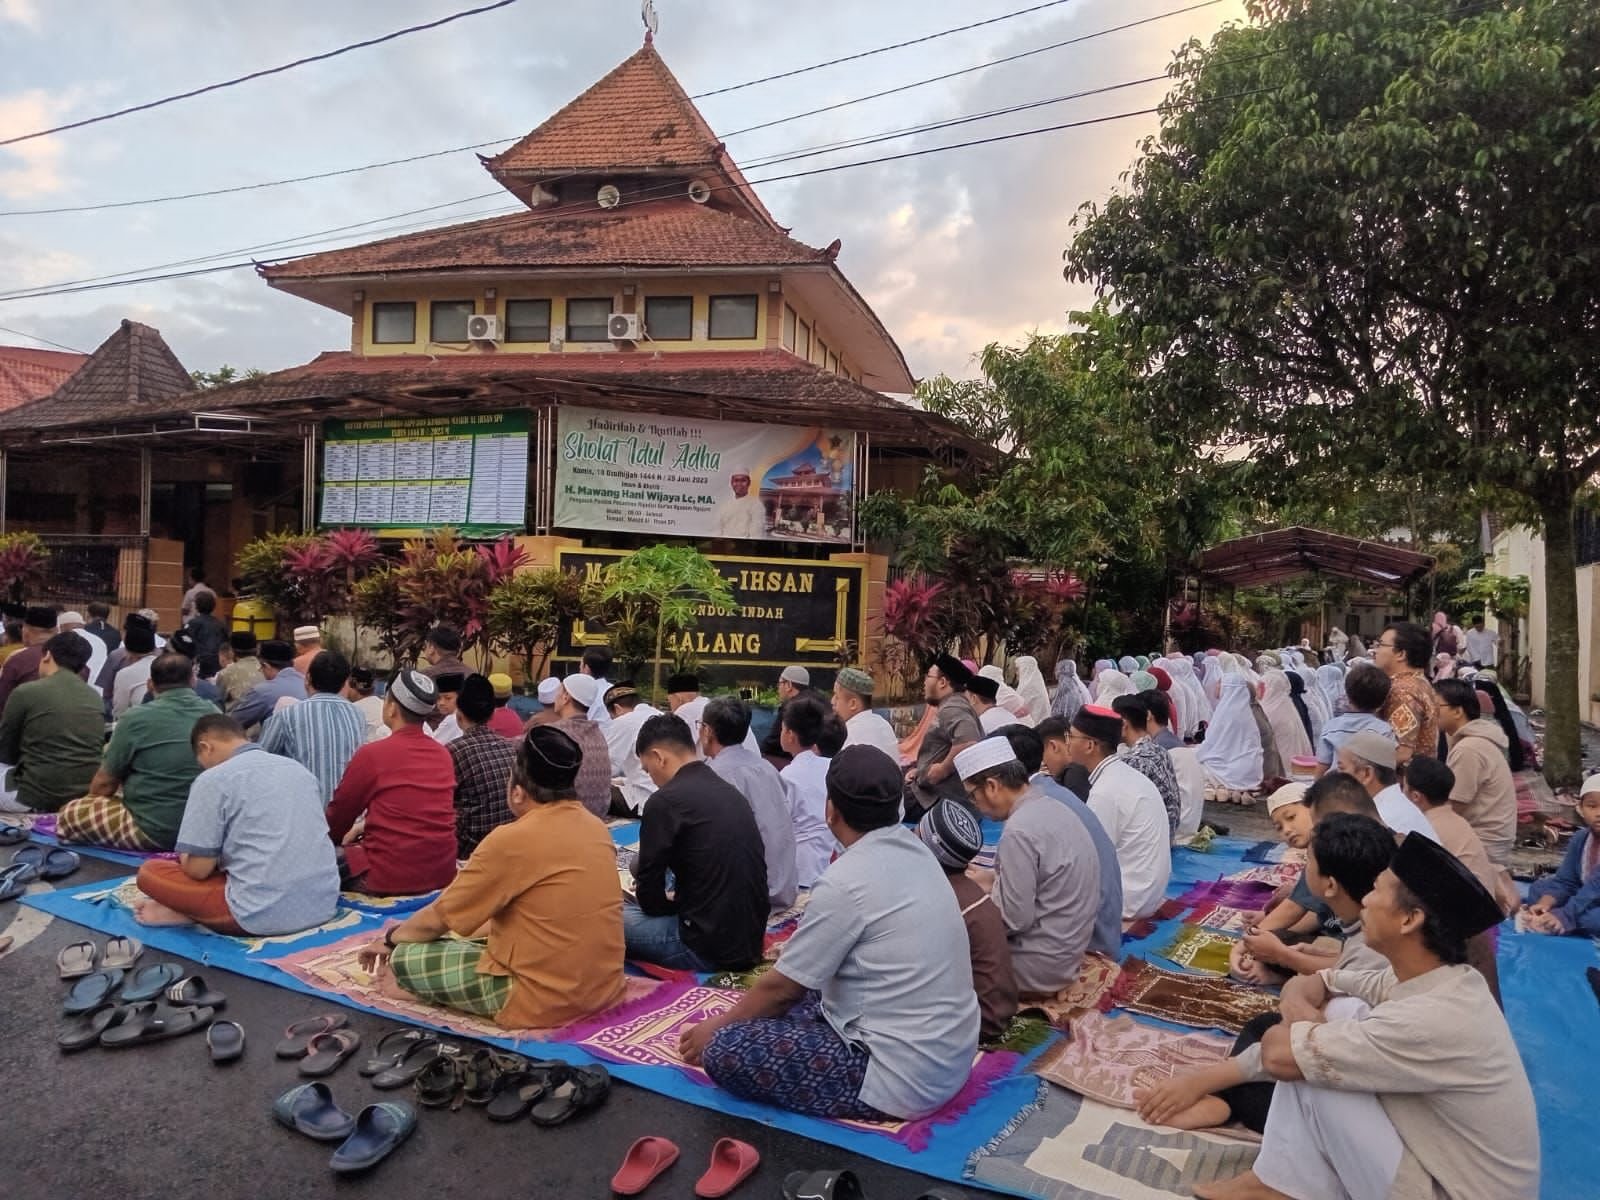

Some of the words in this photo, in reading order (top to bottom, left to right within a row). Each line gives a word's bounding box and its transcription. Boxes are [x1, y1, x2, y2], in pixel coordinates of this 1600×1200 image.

[638, 424, 646, 433] &
[690, 428, 702, 438] !!!
[565, 431, 624, 464] Sholat
[627, 436, 666, 466] Idul
[672, 441, 721, 471] Adha
[573, 467, 594, 476] Kamis,
[677, 475, 691, 483] Juni
[692, 477, 708, 485] 2023
[565, 485, 576, 494] H.
[578, 486, 620, 499] Mawang
[622, 489, 645, 500] Hani
[647, 491, 681, 503] Wijaya
[682, 494, 696, 505] Lc,
[697, 495, 716, 505] MA.
[694, 568, 815, 592] L-IHSAN
[686, 603, 737, 617] ONDOK
[741, 606, 784, 619] INDAH
